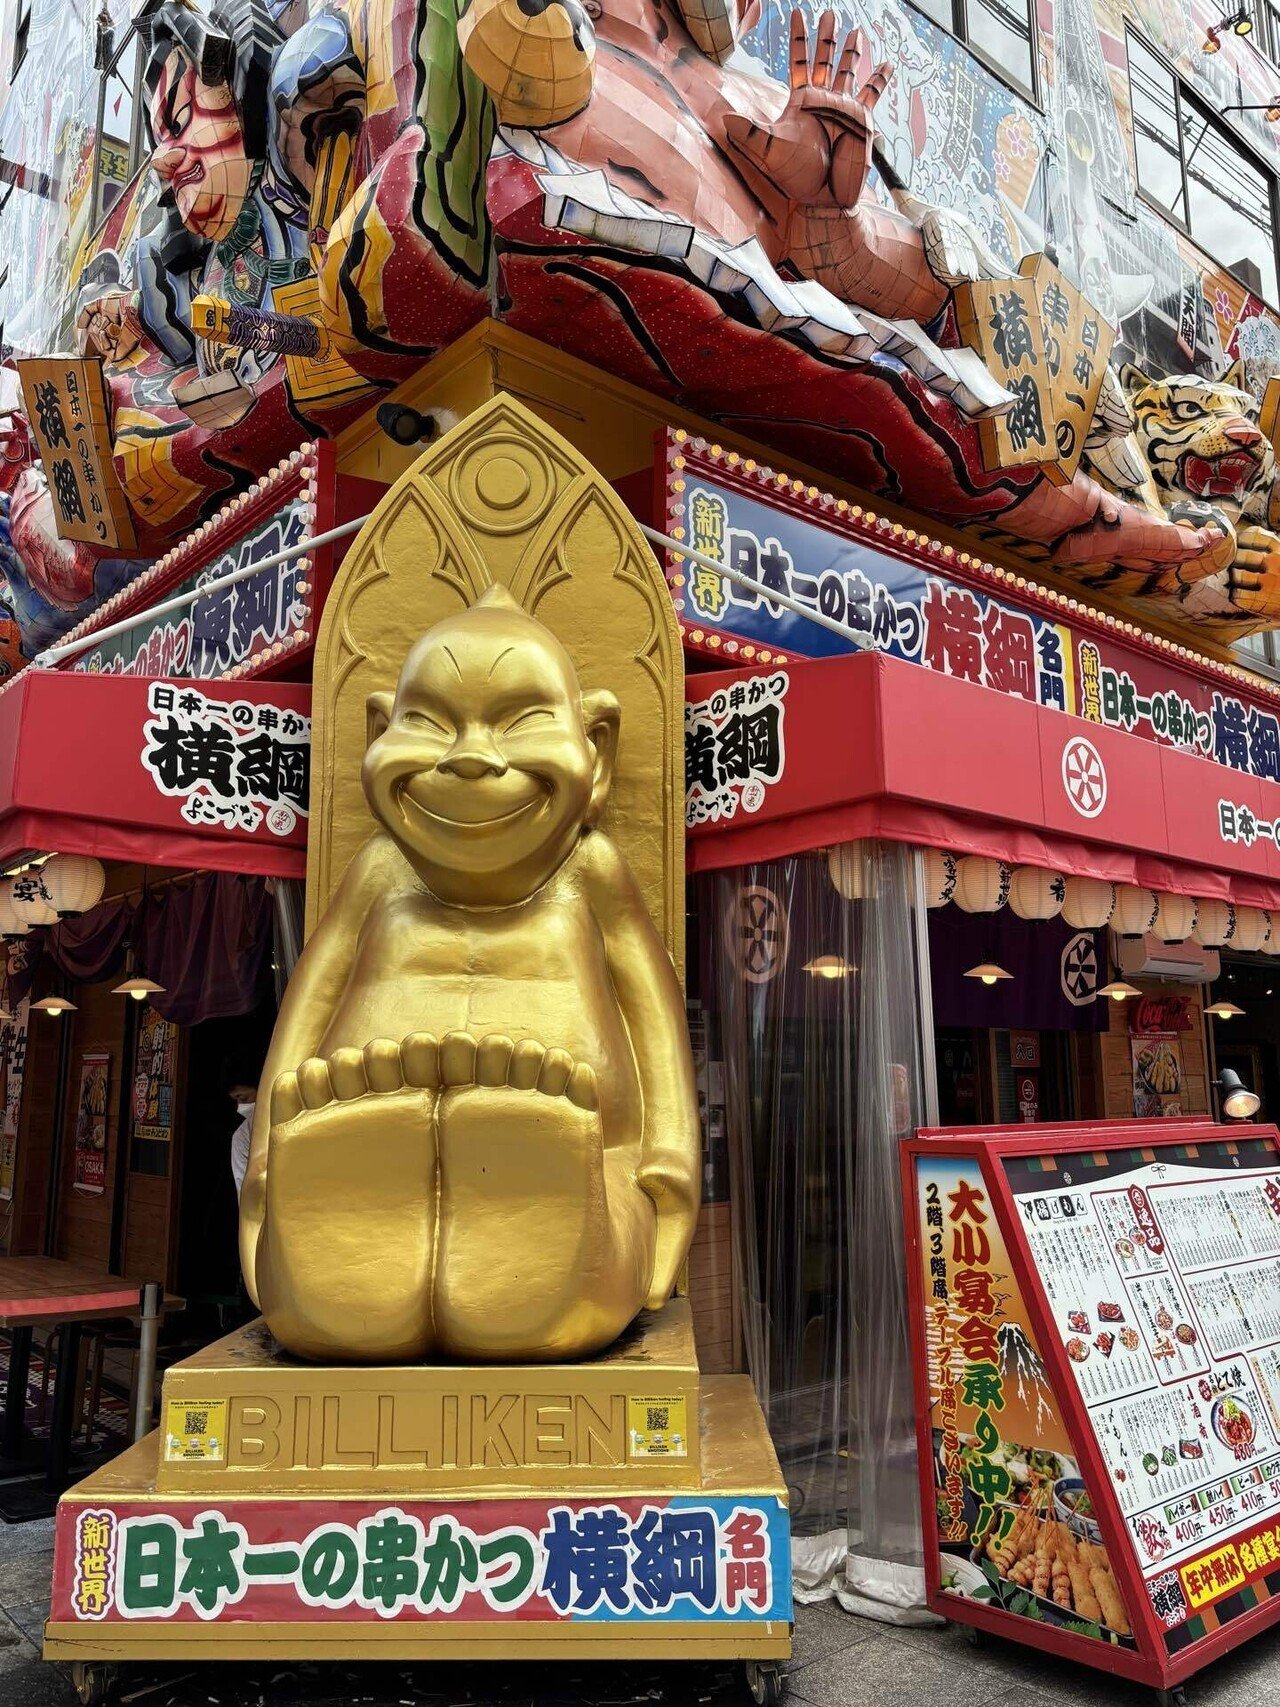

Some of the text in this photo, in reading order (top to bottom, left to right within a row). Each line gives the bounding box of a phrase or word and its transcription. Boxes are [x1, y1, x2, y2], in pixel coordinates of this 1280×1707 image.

[696, 499, 1064, 711] 新世界 日本一の串かつ 横綱 名門
[153, 687, 311, 735] 日本一の串か
[685, 676, 785, 721] 一の串かつ
[1082, 645, 1280, 779] 新世界 日本一の串かつ 横綱
[148, 715, 311, 811] 横綱
[187, 797, 259, 827] よこづな
[226, 1394, 627, 1470] BILLIKEN
[1238, 1473, 1256, 1489] ビール
[1167, 1497, 1199, 1521] ハイボール
[78, 1508, 768, 1614] 新世界 日本一の串かつ 横綱 名門
[1240, 1525, 1280, 1574] 各種宴
[1185, 1550, 1241, 1600] 年中無休
